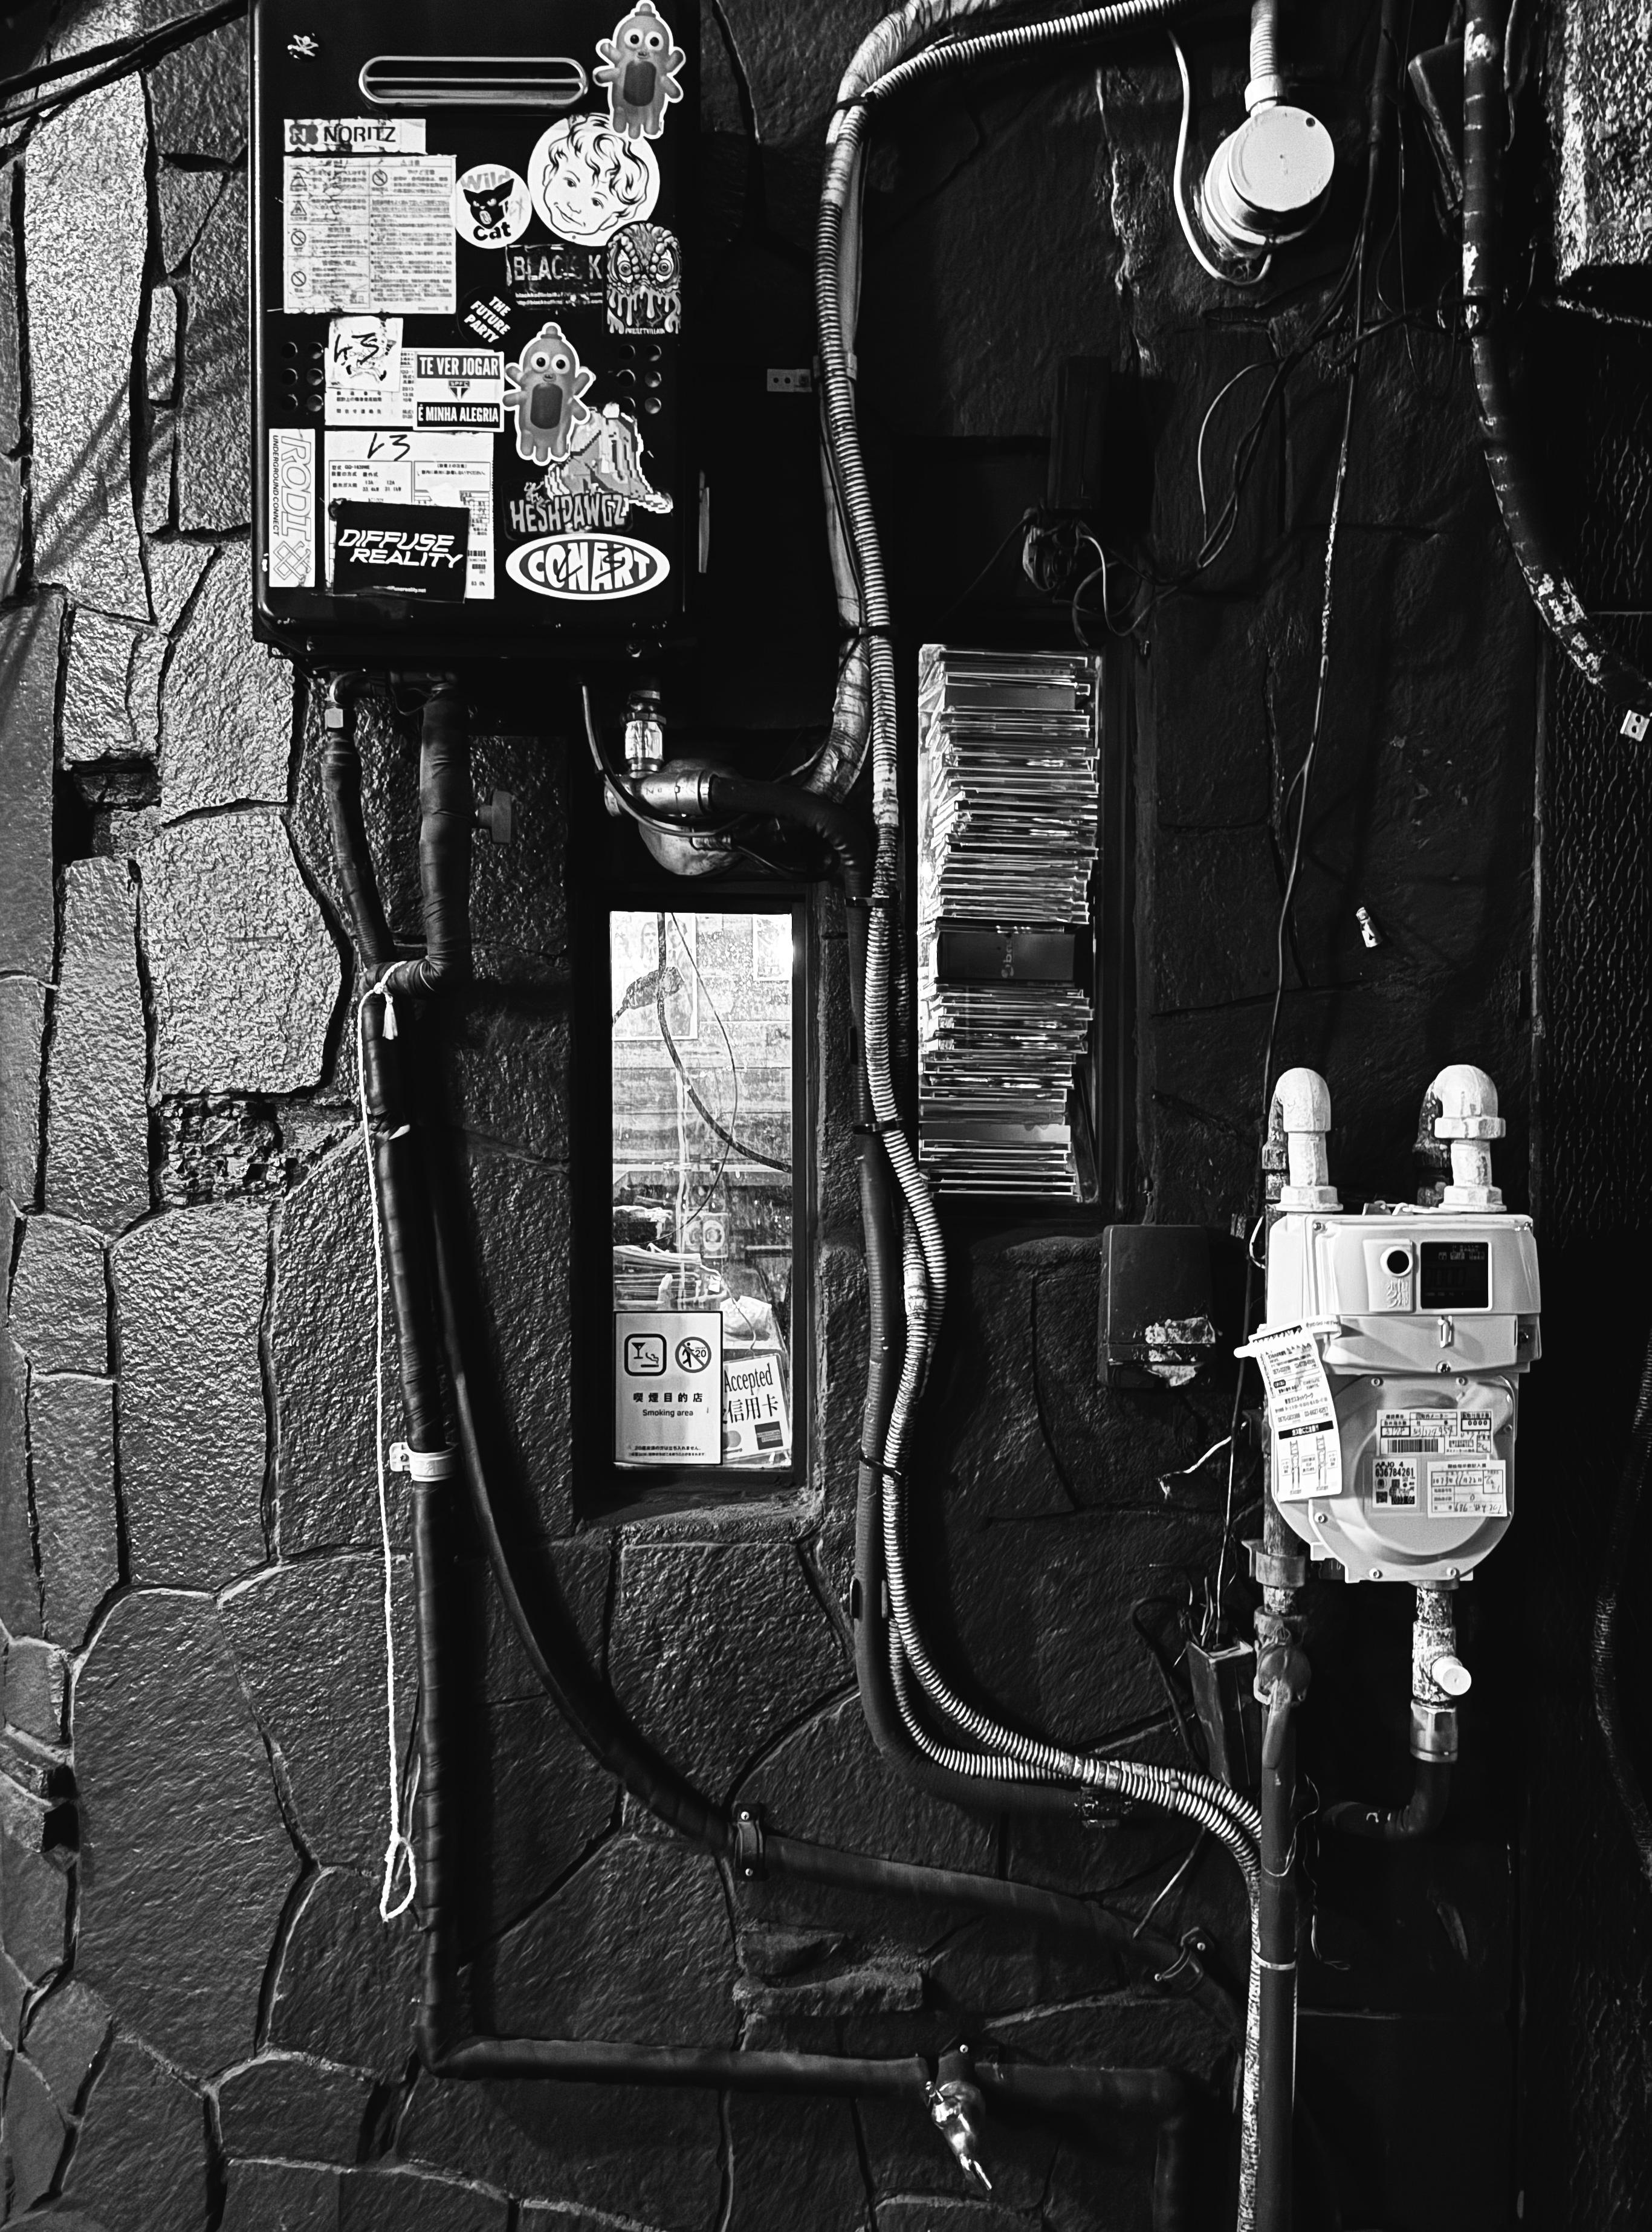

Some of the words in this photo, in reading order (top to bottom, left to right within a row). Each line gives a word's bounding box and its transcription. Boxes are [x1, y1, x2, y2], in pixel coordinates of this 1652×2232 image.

[324, 126, 396, 143] NORITZ
[473, 221, 511, 241] Cat
[488, 296, 511, 317] THE
[470, 300, 511, 335] FUTURE
[464, 314, 500, 343] PARTY
[419, 357, 434, 375] TE
[436, 357, 459, 375] VER
[461, 357, 499, 376] JOGAR
[426, 406, 458, 422] MINHA
[459, 406, 499, 423] ALEGRIA
[280, 436, 312, 542] RODI
[510, 493, 625, 532] HESHDAWGZ
[338, 529, 455, 553] DIFFUSE
[350, 548, 464, 568] REALITY
[528, 542, 650, 592] CONART
[695, 1349, 707, 1358] 20
[724, 1363, 774, 1396] Accepted
[633, 1392, 703, 1403] 喫煙目的店
[643, 1409, 675, 1418] Smoking
[1375, 1467, 1414, 1477] 636784261
